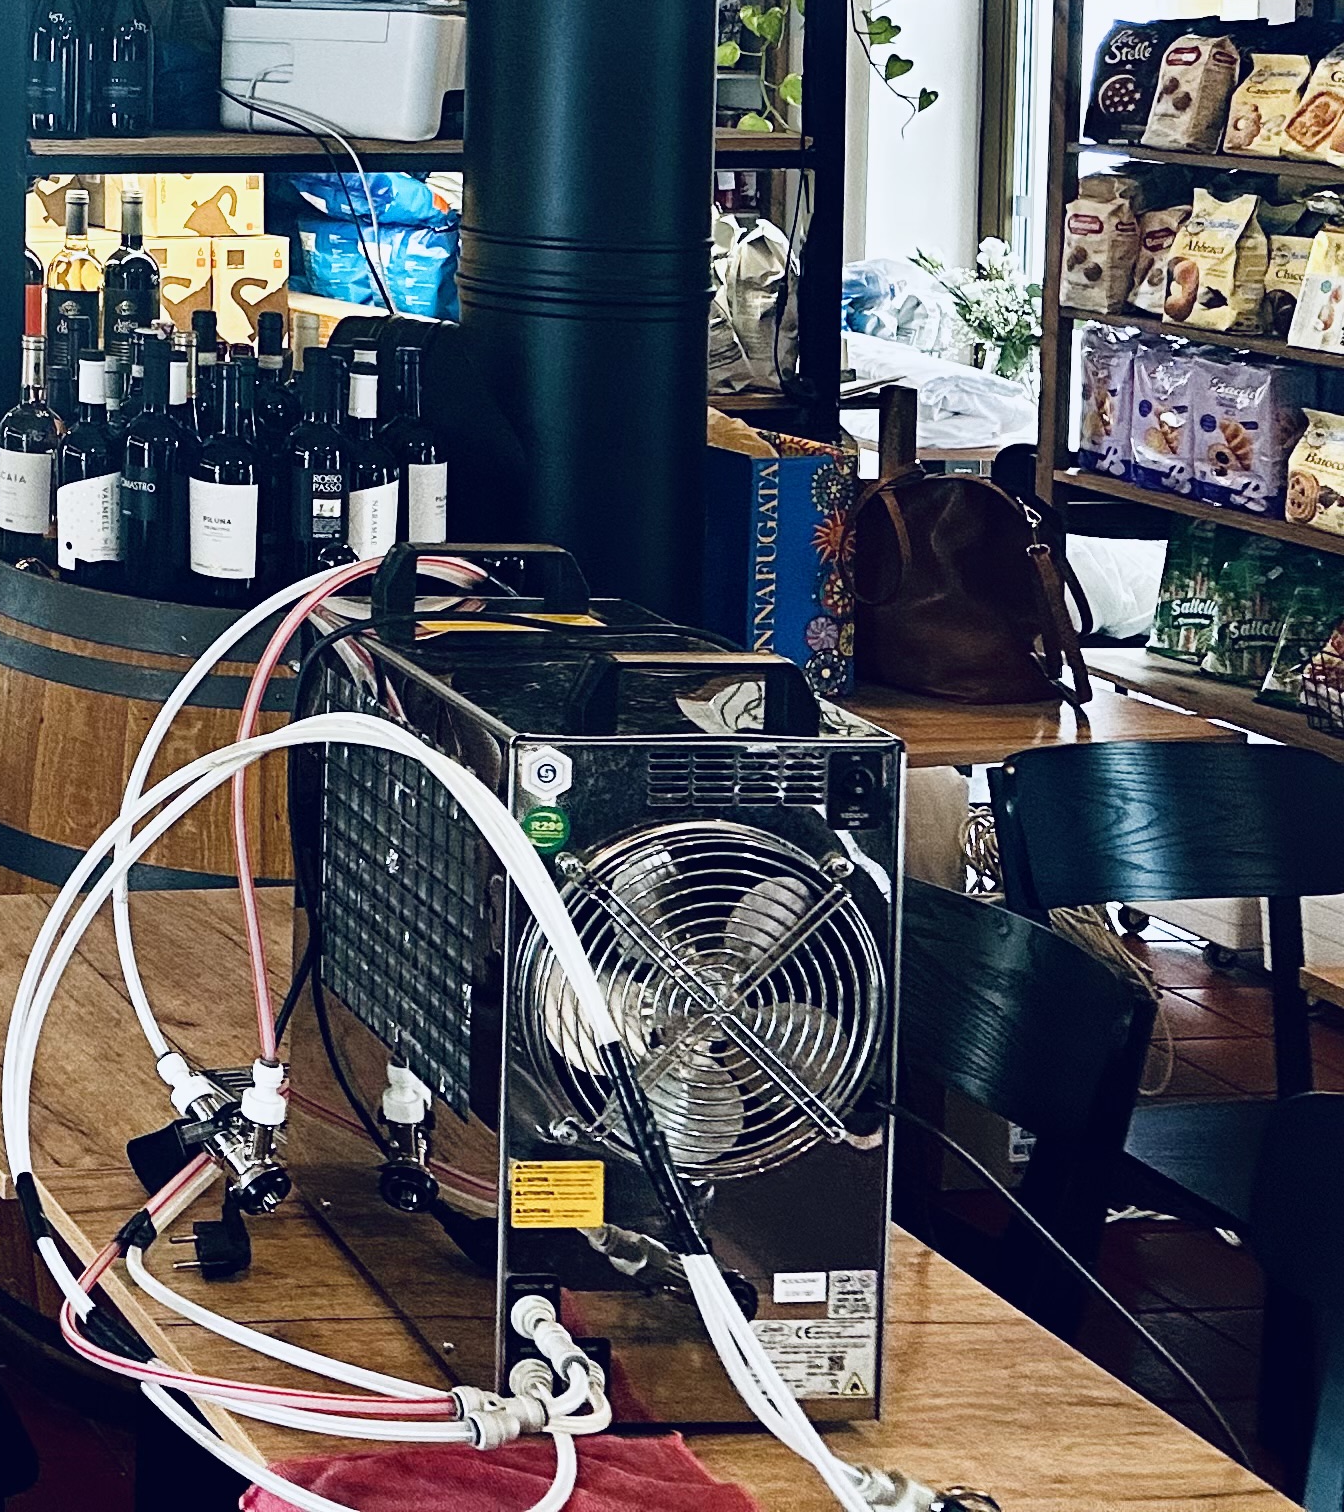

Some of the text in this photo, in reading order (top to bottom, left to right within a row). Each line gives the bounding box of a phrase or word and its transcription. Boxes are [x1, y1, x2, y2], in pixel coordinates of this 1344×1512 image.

[1104, 43, 1152, 64] Stelle
[312, 474, 342, 483] ROSSO
[312, 483, 342, 492] PASSO
[753, 462, 779, 653] NNAFUGATA
